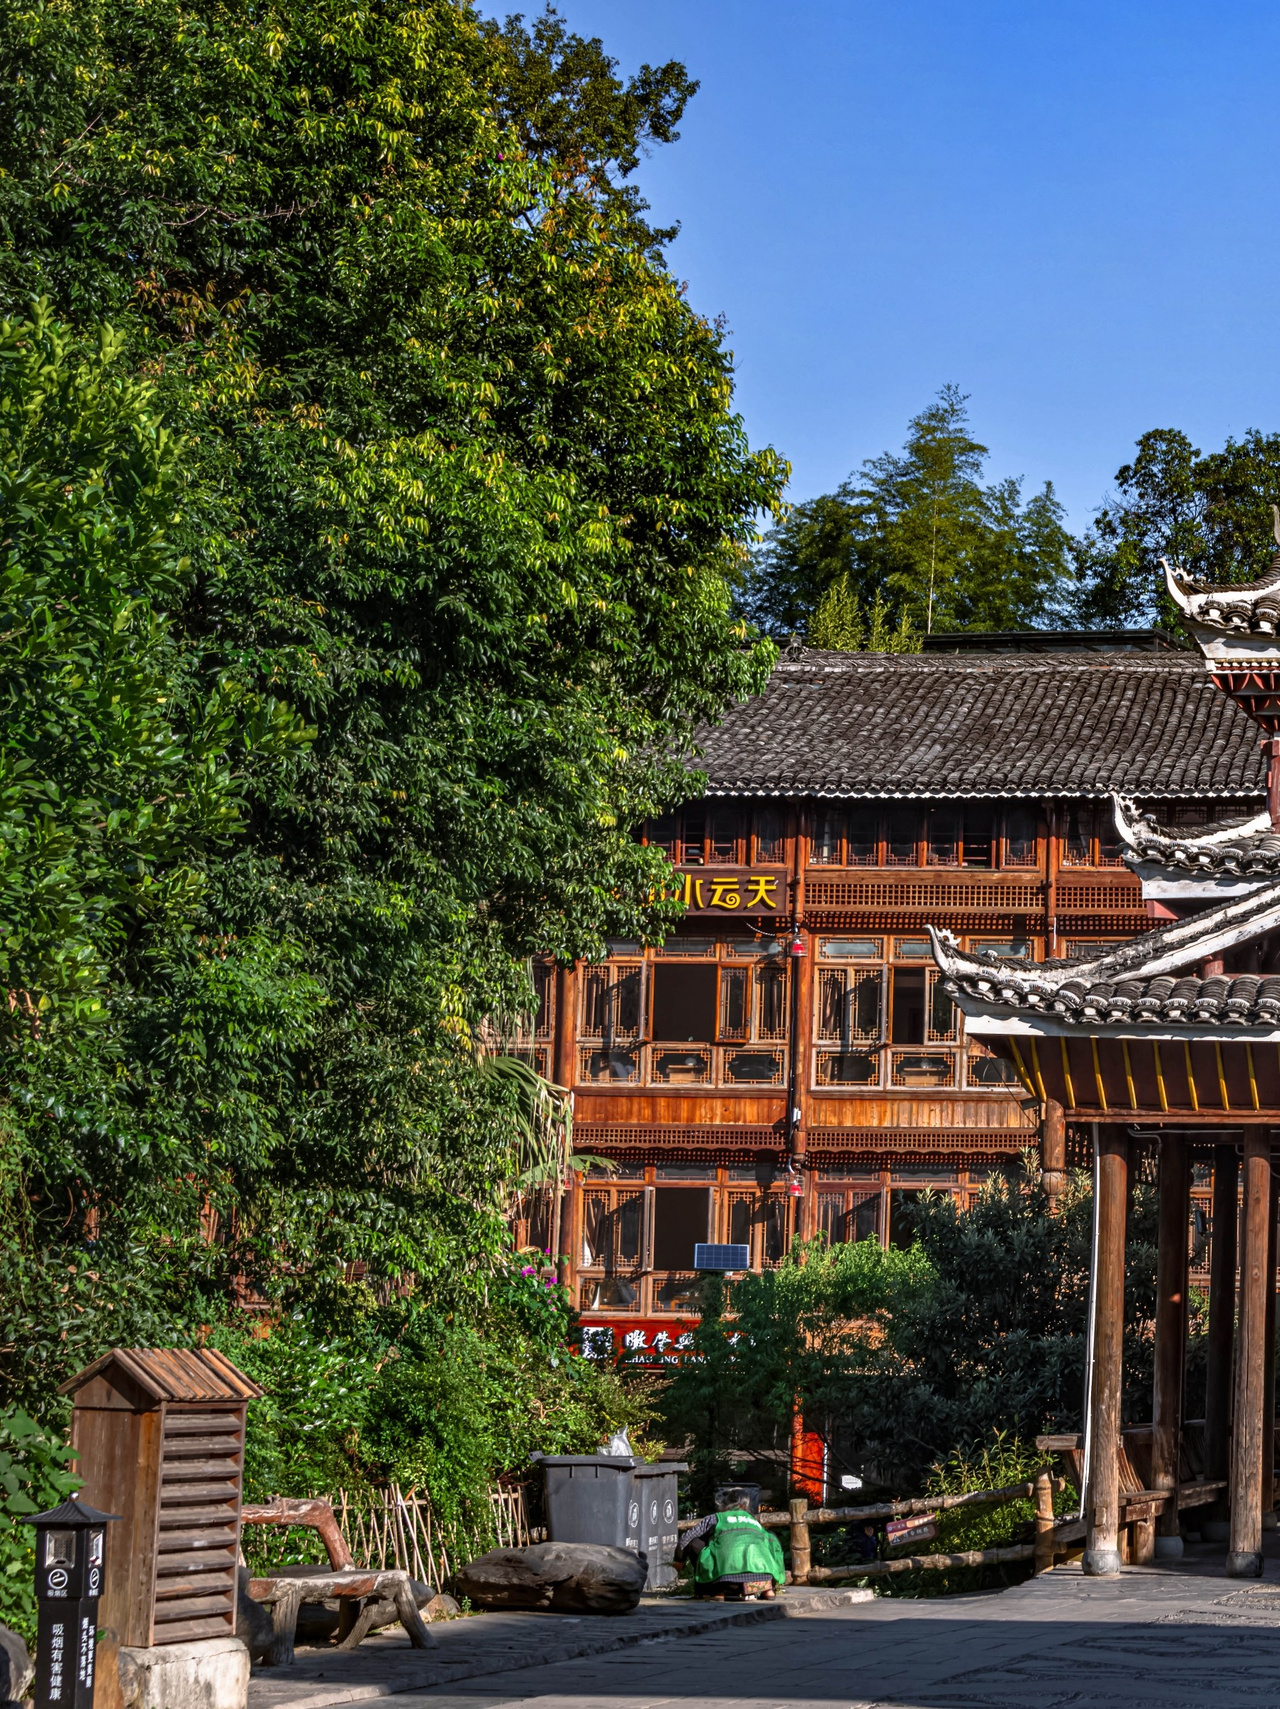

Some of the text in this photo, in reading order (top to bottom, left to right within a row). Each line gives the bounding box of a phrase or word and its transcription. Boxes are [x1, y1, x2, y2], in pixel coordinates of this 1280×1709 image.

[49, 1623, 65, 1701] 吸烟有害健康
